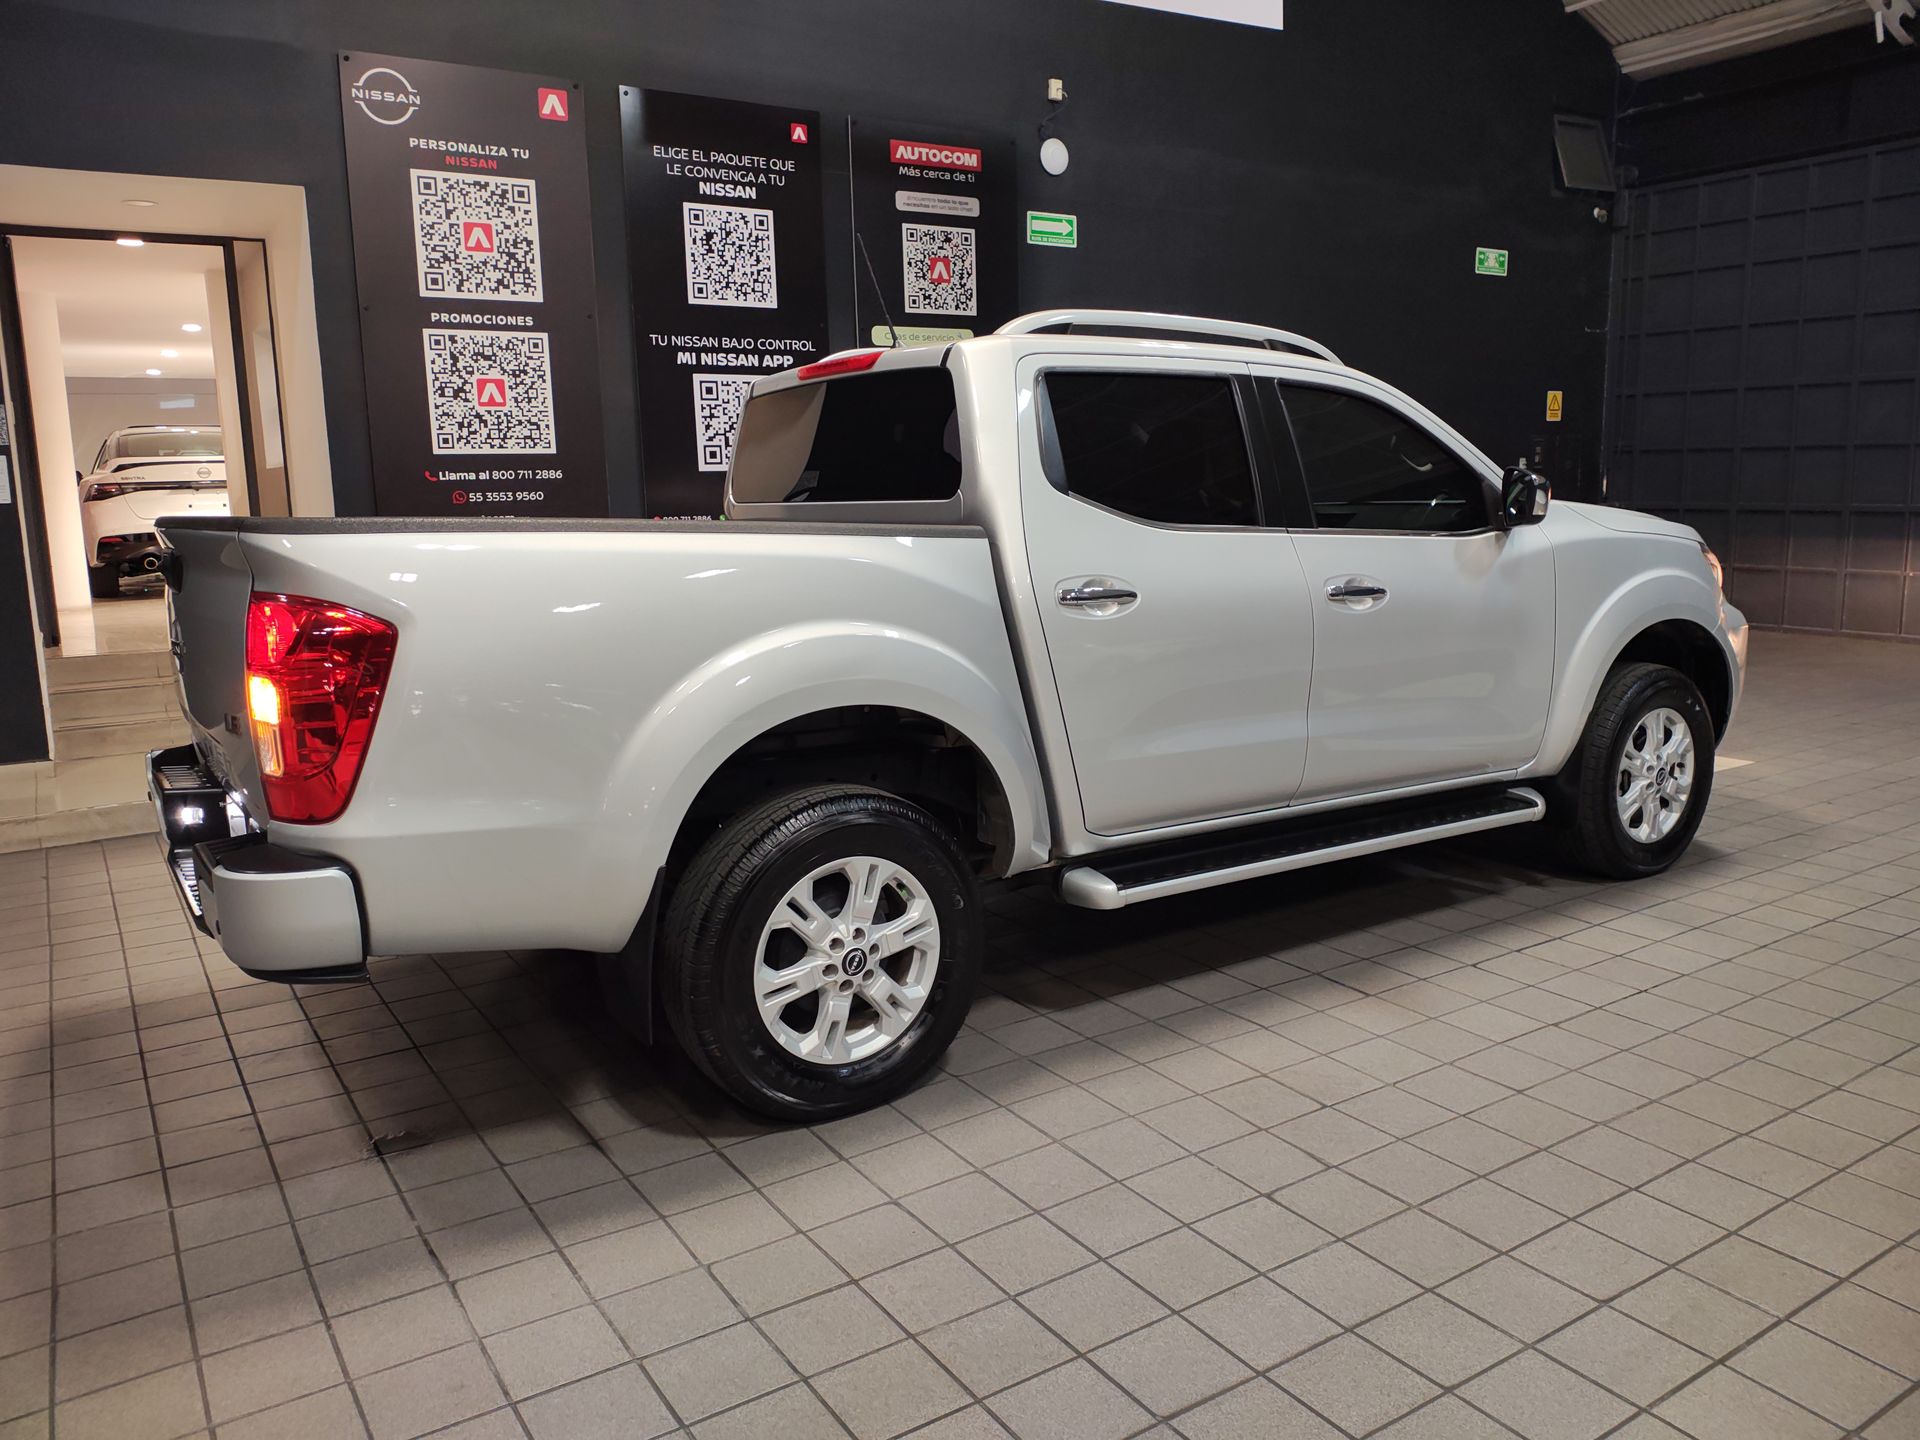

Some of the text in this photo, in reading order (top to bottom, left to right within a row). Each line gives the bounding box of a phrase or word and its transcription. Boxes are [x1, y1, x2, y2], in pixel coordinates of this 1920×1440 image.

[351, 87, 421, 105] NISSAN
[408, 137, 530, 159] PERSONALIZA TU
[895, 145, 978, 167] AUTOCOM
[445, 155, 498, 170] NISSAN
[653, 145, 796, 172] ELIGE EL PAQUETE QUE
[666, 163, 786, 187] LE CONVENGA A TU
[898, 165, 976, 183] Más cerca de ti
[698, 180, 757, 200] NISSAN
[430, 312, 534, 326] PROMOCIONES
[649, 334, 817, 352] TU NISSAN BAJO CONTROL
[908, 331, 920, 342] de
[922, 332, 955, 343] servicio
[676, 351, 794, 368] MI NISSAN APP
[438, 469, 563, 481] Llama al 800 711 2886
[468, 491, 545, 502] 55 3553 9560
